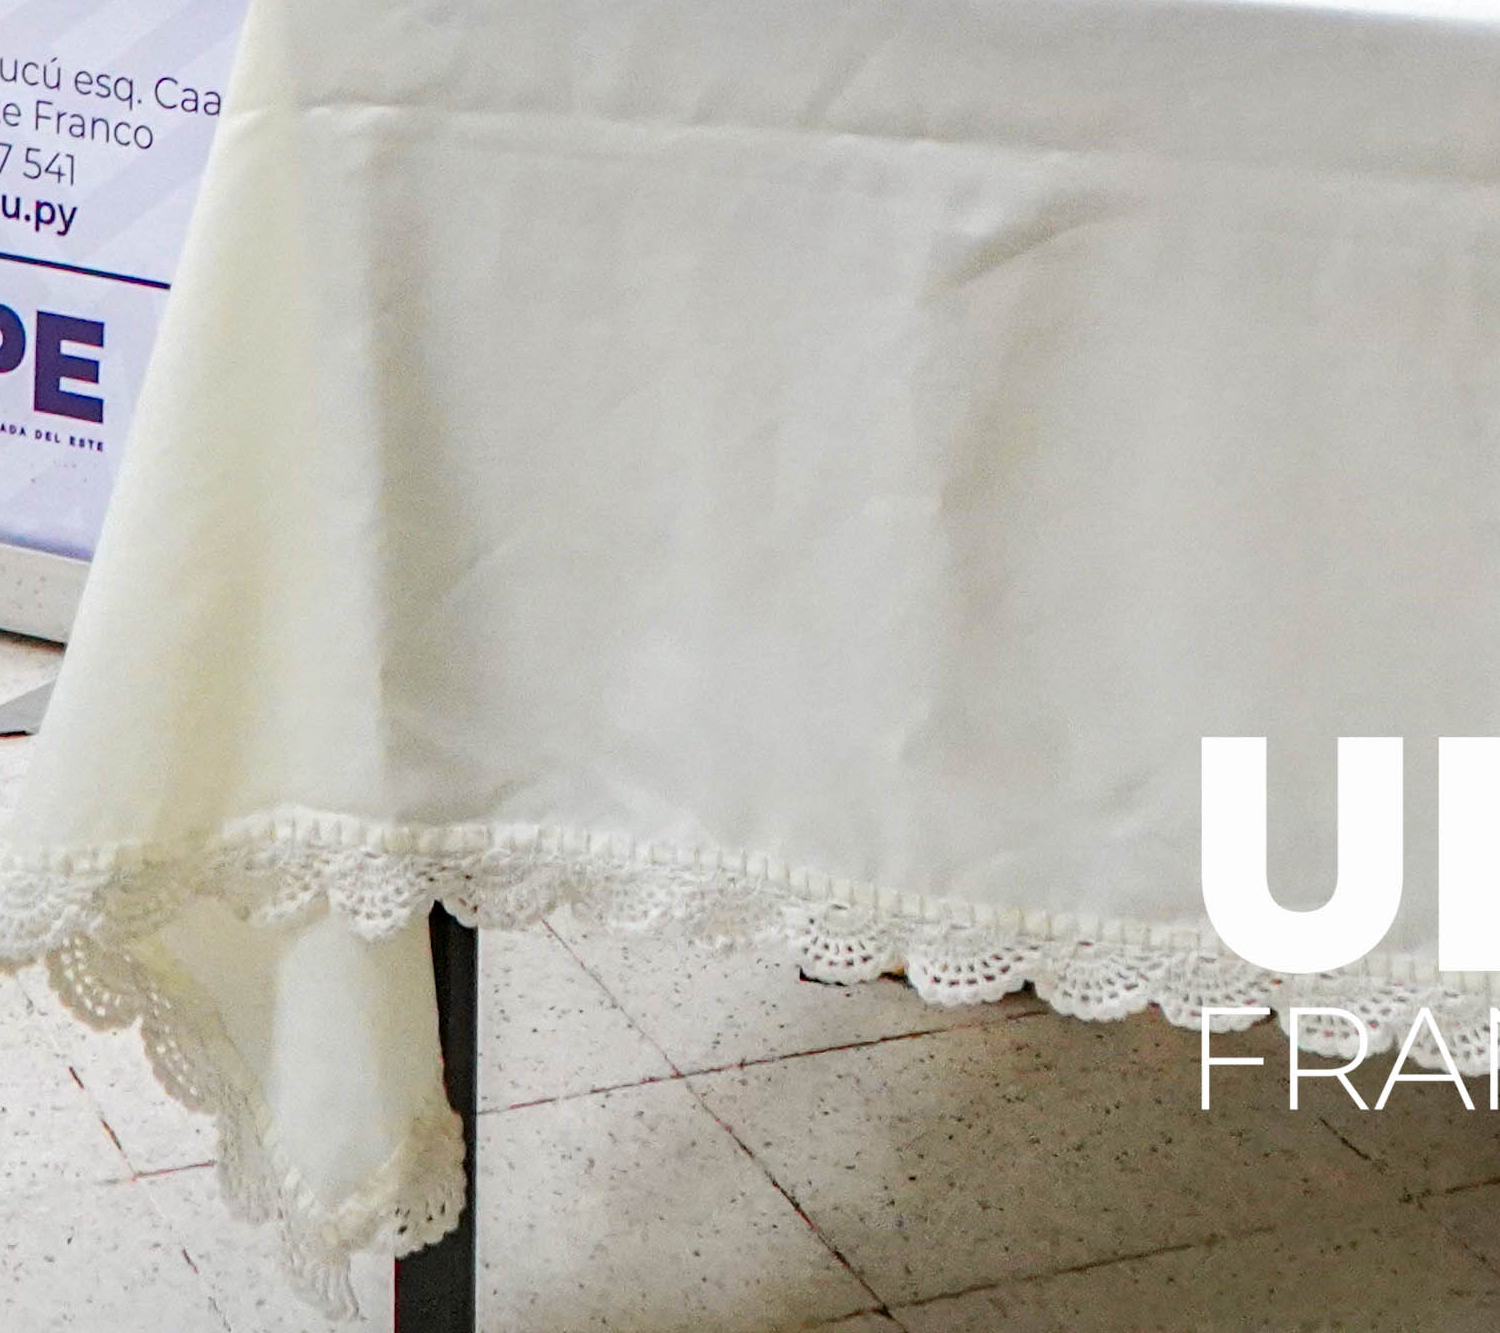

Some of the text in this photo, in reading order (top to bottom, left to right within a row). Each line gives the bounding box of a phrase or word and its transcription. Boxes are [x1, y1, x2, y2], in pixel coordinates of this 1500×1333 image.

[73, 69, 143, 107] esq.
[153, 75, 222, 117] Caa
[33, 101, 155, 151] Franco
[22, 148, 77, 186] 541
[34, 429, 61, 444] DEL
[69, 436, 104, 452] ESTE
